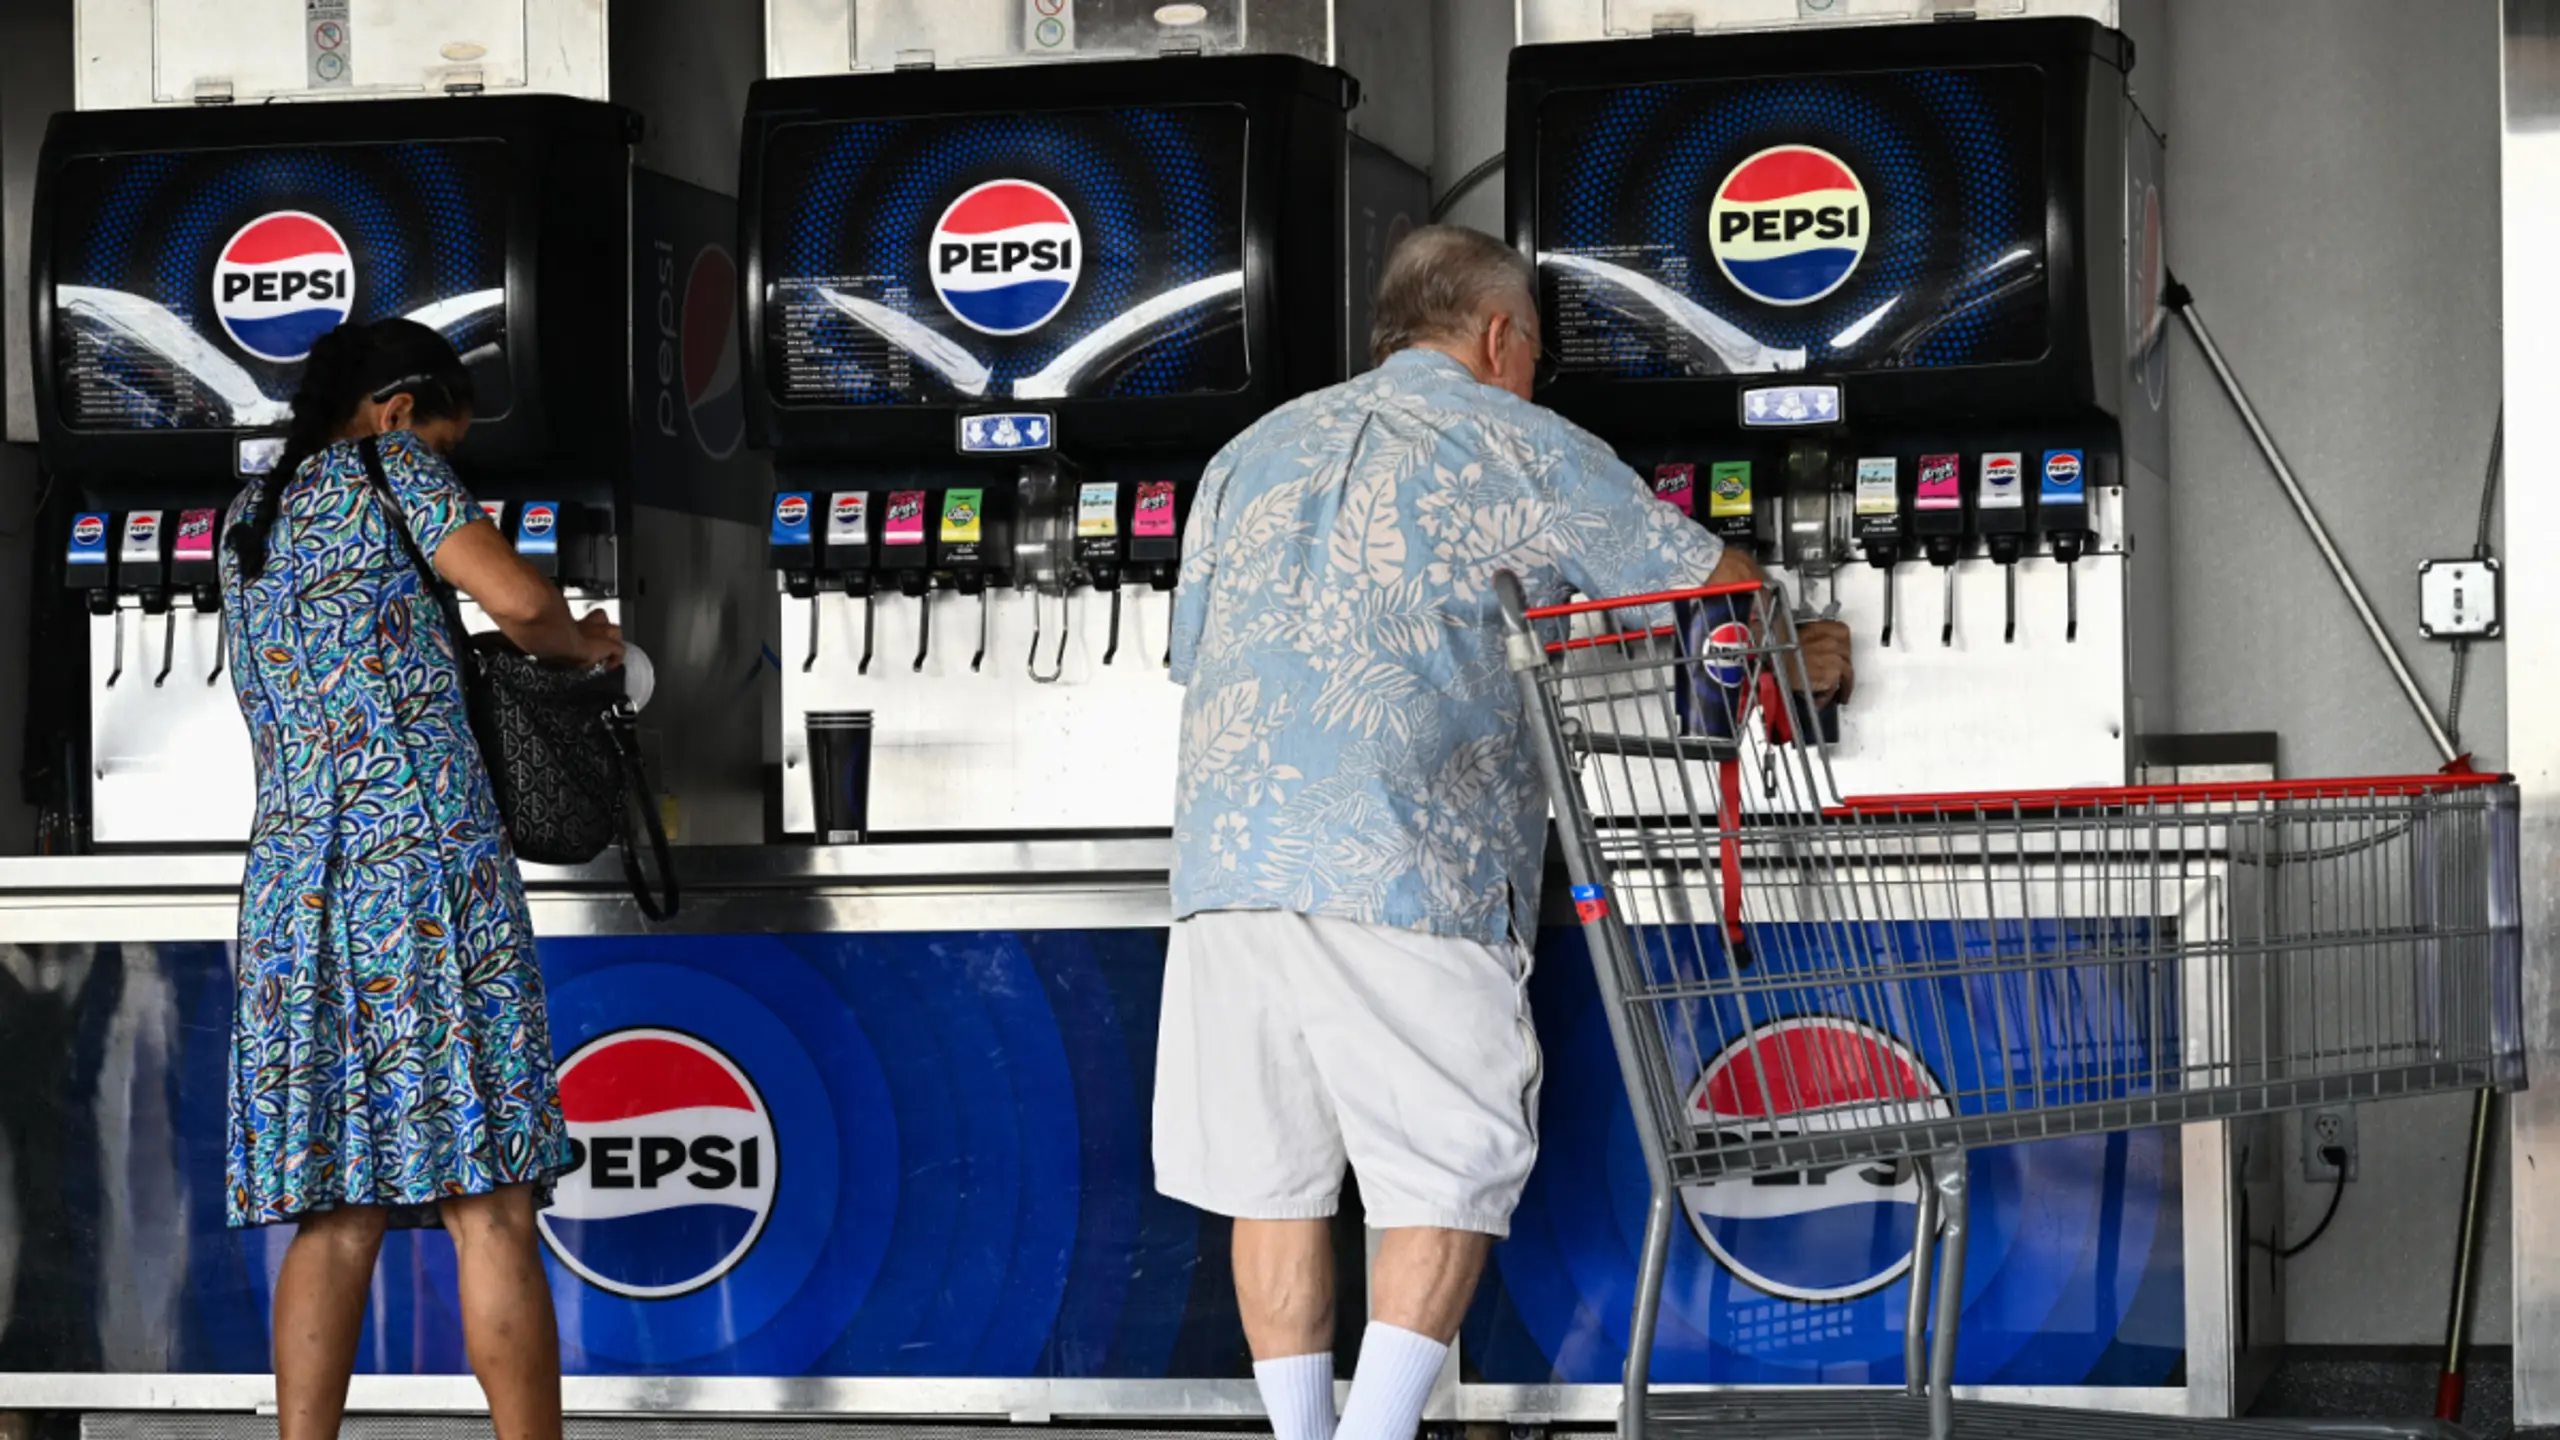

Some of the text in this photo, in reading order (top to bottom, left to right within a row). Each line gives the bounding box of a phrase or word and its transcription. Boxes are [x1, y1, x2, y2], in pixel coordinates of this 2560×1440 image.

[1719, 205, 1859, 243] PEPSI
[939, 238, 1072, 274] PEPSI
[223, 269, 346, 303] PEPSI
[655, 239, 678, 437] pepsi
[2047, 464, 2078, 472] PEPSI
[526, 515, 551, 523] PEPSI
